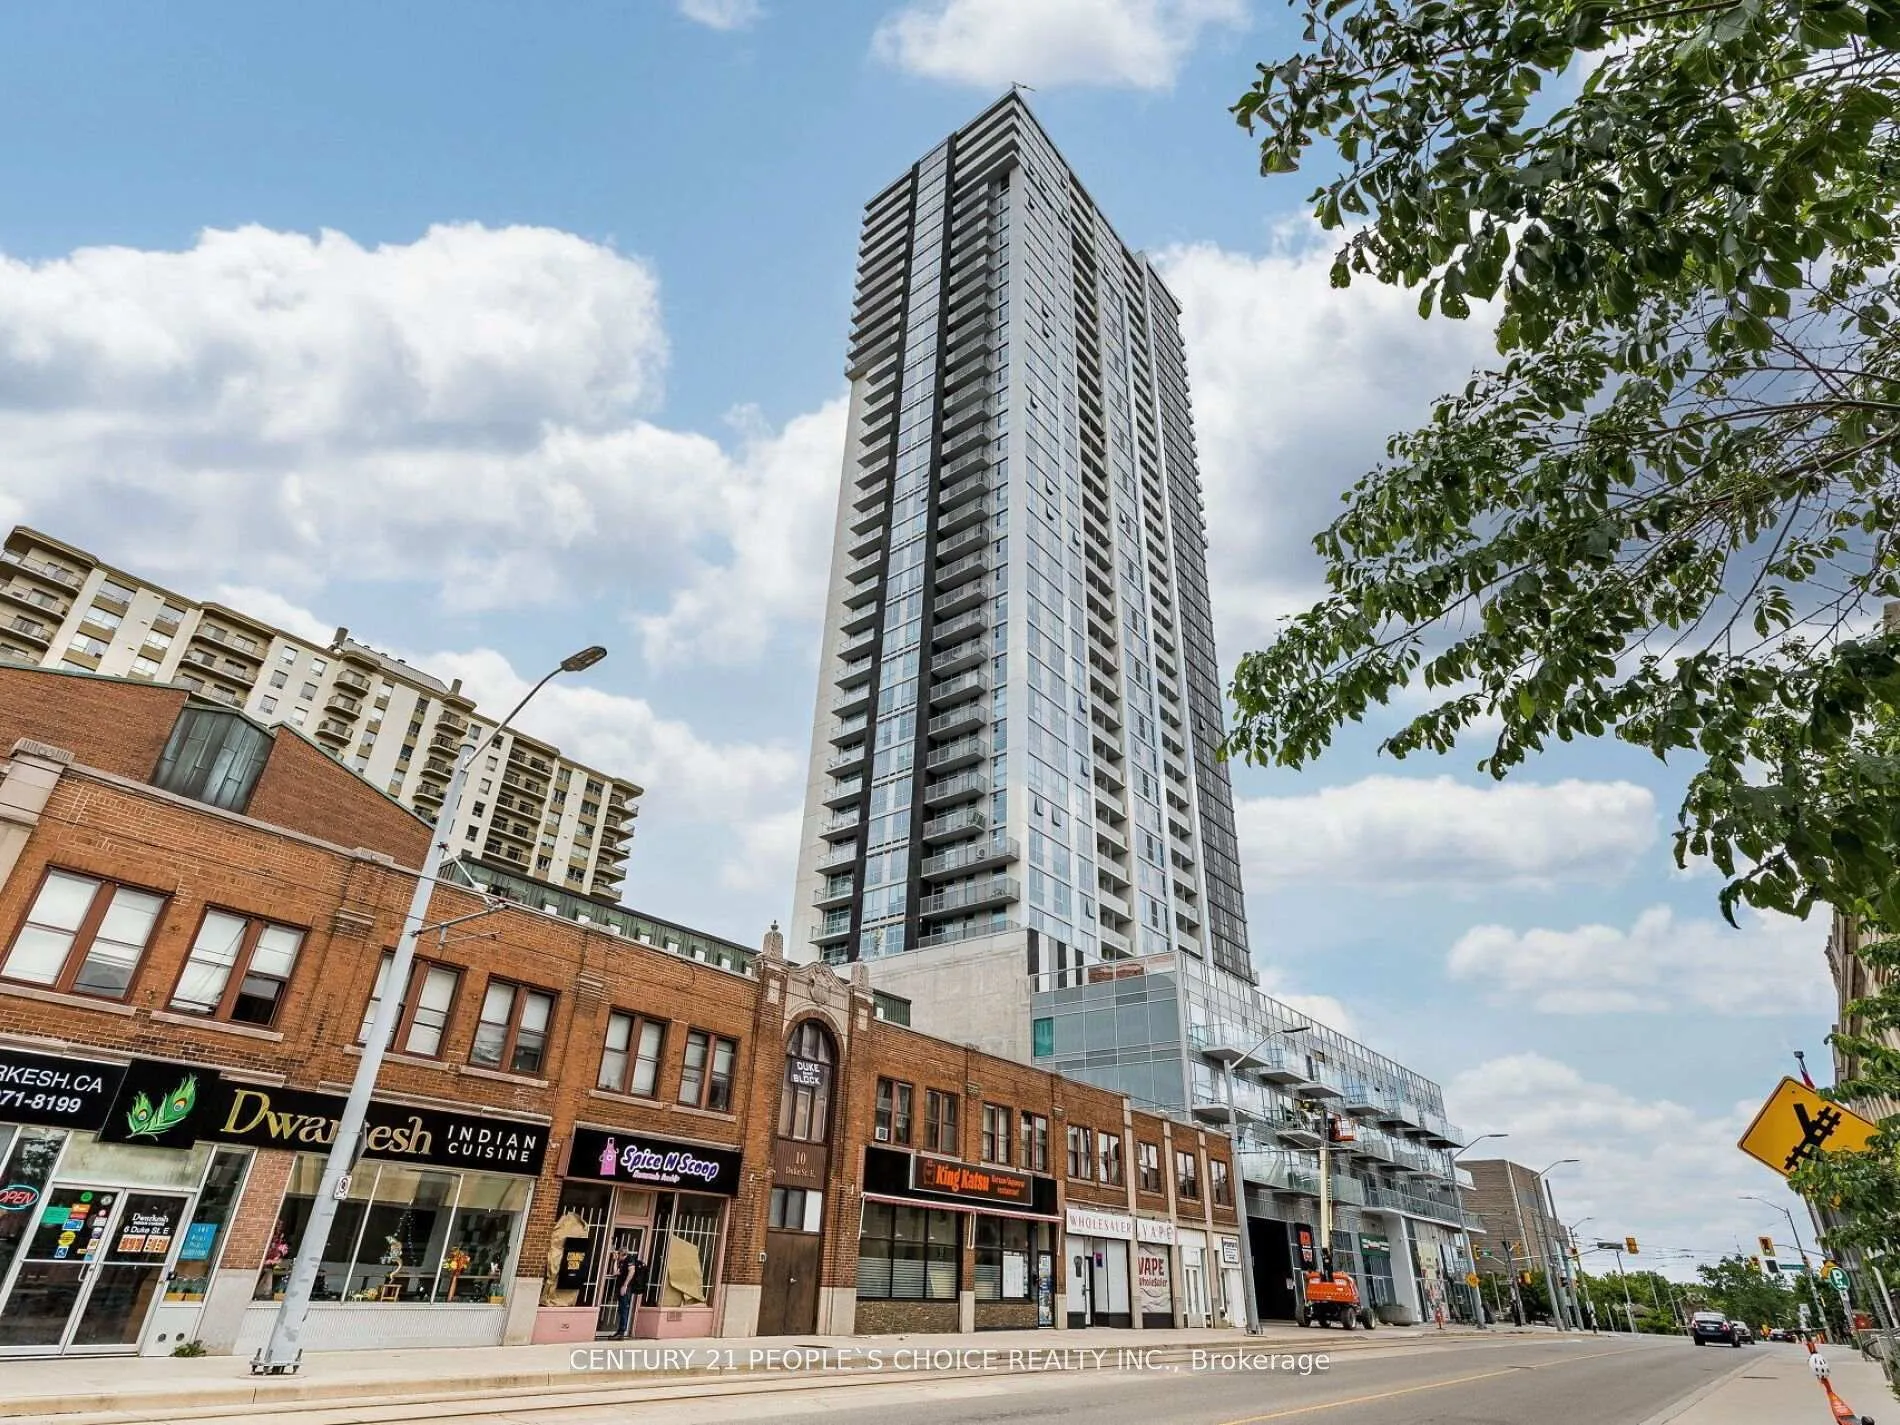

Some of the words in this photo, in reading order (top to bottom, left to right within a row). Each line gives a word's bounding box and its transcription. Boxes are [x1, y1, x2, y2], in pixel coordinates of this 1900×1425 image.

[796, 1061, 820, 1072] DUKE
[793, 1073, 822, 1085] BLOCK
[447, 1124, 537, 1150] INDIAN
[448, 1142, 530, 1162] CUISINE
[620, 1144, 664, 1172] Spice
[664, 1151, 679, 1171] N
[677, 1153, 720, 1181] Scoop
[935, 1165, 961, 1192] King
[961, 1168, 990, 1192] Katsu
[0, 1190, 36, 1204] OPEN
[130, 1226, 150, 1234] Duke
[1069, 1215, 1131, 1233] WHOLESALER
[1142, 1223, 1173, 1240] VAPE
[1138, 1256, 1164, 1276] VAPE
